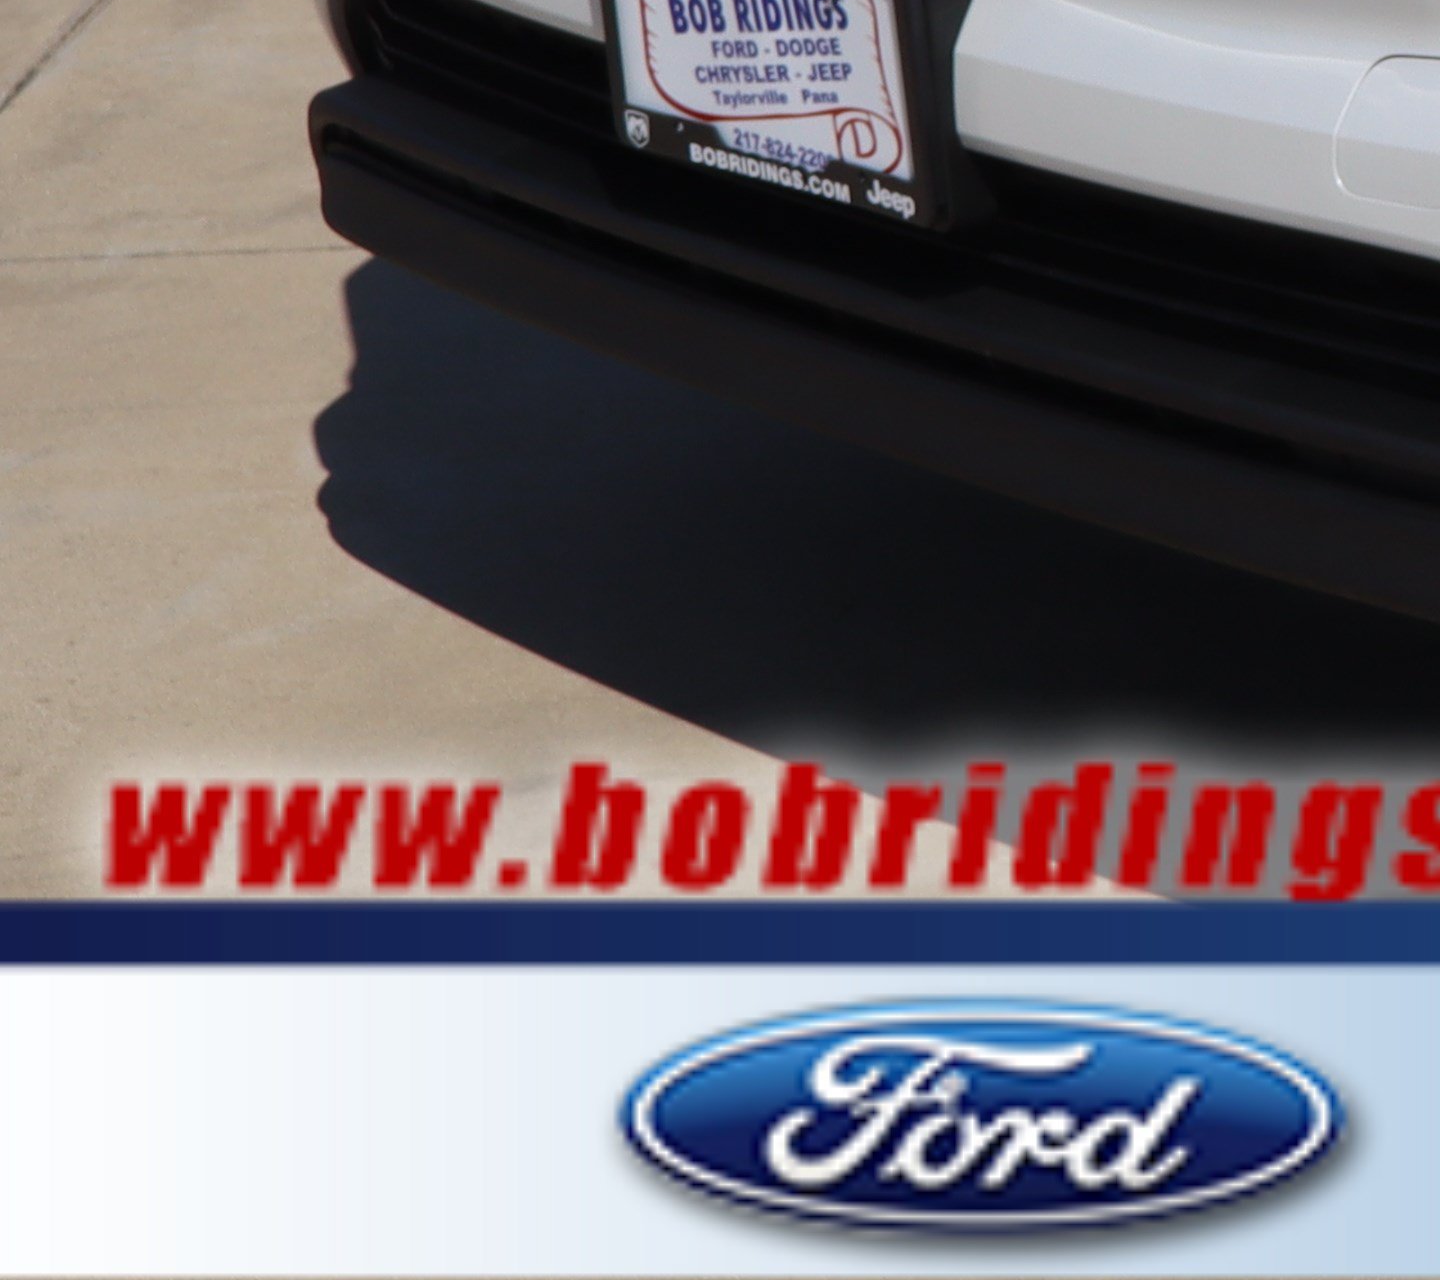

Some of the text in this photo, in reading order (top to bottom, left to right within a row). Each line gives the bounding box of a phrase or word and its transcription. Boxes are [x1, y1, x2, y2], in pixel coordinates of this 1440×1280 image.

[711, 40, 759, 58] FORD
[776, 38, 842, 57] DODGE
[694, 63, 790, 84] CHRYSLER
[808, 62, 852, 82] JEEP
[712, 90, 839, 108] Taylorville Pana
[689, 142, 916, 219] BOBRIDINGS.COM Jeep
